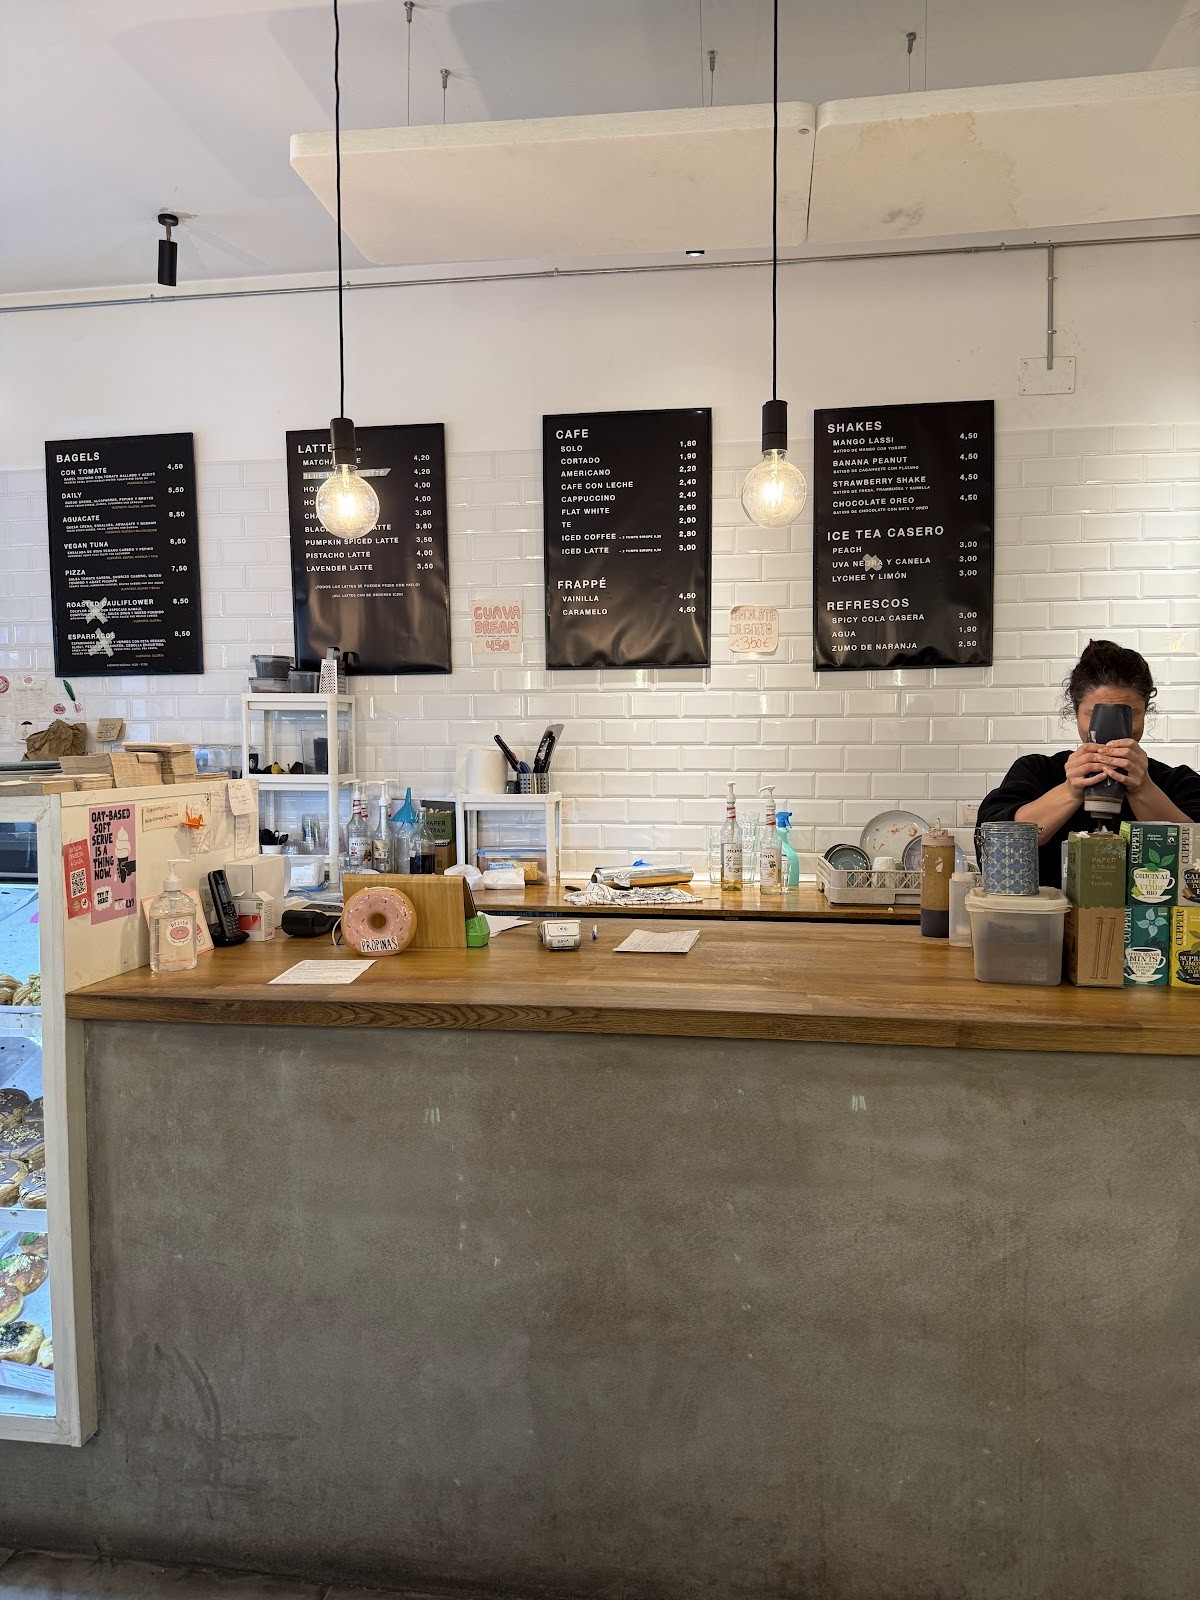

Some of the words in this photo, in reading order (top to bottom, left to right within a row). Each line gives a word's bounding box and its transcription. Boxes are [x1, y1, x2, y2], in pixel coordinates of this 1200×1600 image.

[827, 421, 883, 434] SHAKES
[555, 429, 589, 439] CAFE
[832, 437, 866, 446] MANGO
[868, 436, 894, 444] LASSI
[959, 432, 978, 440] 4,50
[56, 452, 100, 463] BAGELS
[560, 457, 600, 465] CORTADO
[832, 458, 869, 467] BANANA
[872, 456, 908, 464] PEANUT
[78, 467, 107, 475] TOMATE
[561, 469, 611, 477] AMERICANO
[679, 465, 697, 473] 2,20
[606, 481, 634, 489] LECHE
[679, 478, 697, 486] 2,40
[832, 477, 893, 488] STRAWBERRY
[896, 475, 926, 484] SHAKE
[959, 473, 979, 481] 4,50
[561, 494, 616, 503] CAPPUCCINO
[679, 491, 697, 499] 2,40
[832, 498, 887, 508] CHOCOLATE
[889, 496, 915, 504] OREO
[561, 508, 581, 516] FLAT
[583, 507, 610, 515] WHITE
[62, 515, 100, 523] AGUACATE
[561, 534, 582, 542] ICED
[584, 533, 617, 541] COFFEE
[827, 530, 850, 541] ICE
[855, 529, 882, 539] TEA
[887, 525, 944, 537] CASERO
[344, 537, 373, 545] SPICED
[832, 546, 862, 554] PEACH
[959, 541, 978, 549] 3,00
[895, 557, 931, 565] CANELA
[959, 555, 978, 563] 3,00
[832, 574, 866, 582] LYCHEE
[878, 571, 907, 580] LIMÓN
[959, 569, 978, 577] 3,00
[557, 577, 607, 589] FRAPPÉ
[678, 592, 697, 600] 4,50
[66, 600, 100, 608] ROASTED
[101, 598, 154, 607] CAULIFLOWER
[826, 598, 910, 611] REFRESCOS
[474, 605, 521, 620] GUAVA
[562, 608, 608, 616] CARAMELO
[678, 606, 697, 614] 4,50
[832, 616, 858, 624] SPICY
[861, 615, 885, 623] COLA
[888, 613, 925, 621] CASERA
[68, 632, 116, 640] ESPARRAGOS
[832, 644, 857, 652] ZUMO
[875, 642, 918, 650] NARANJA
[958, 640, 977, 648] 2,50
[92, 808, 131, 823] OAT-BASED
[94, 822, 111, 834] SOFT
[92, 833, 113, 846] SERVE
[1131, 827, 1140, 864] CUPPER
[1181, 826, 1190, 864] CUPPER
[95, 846, 102, 857] IS
[103, 845, 108, 856] A
[93, 856, 114, 869] THING
[94, 868, 112, 881] NOW.
[1124, 907, 1132, 943] CUPPER
[1175, 909, 1184, 946] CUPPER
[361, 938, 398, 951] PROPINAS
